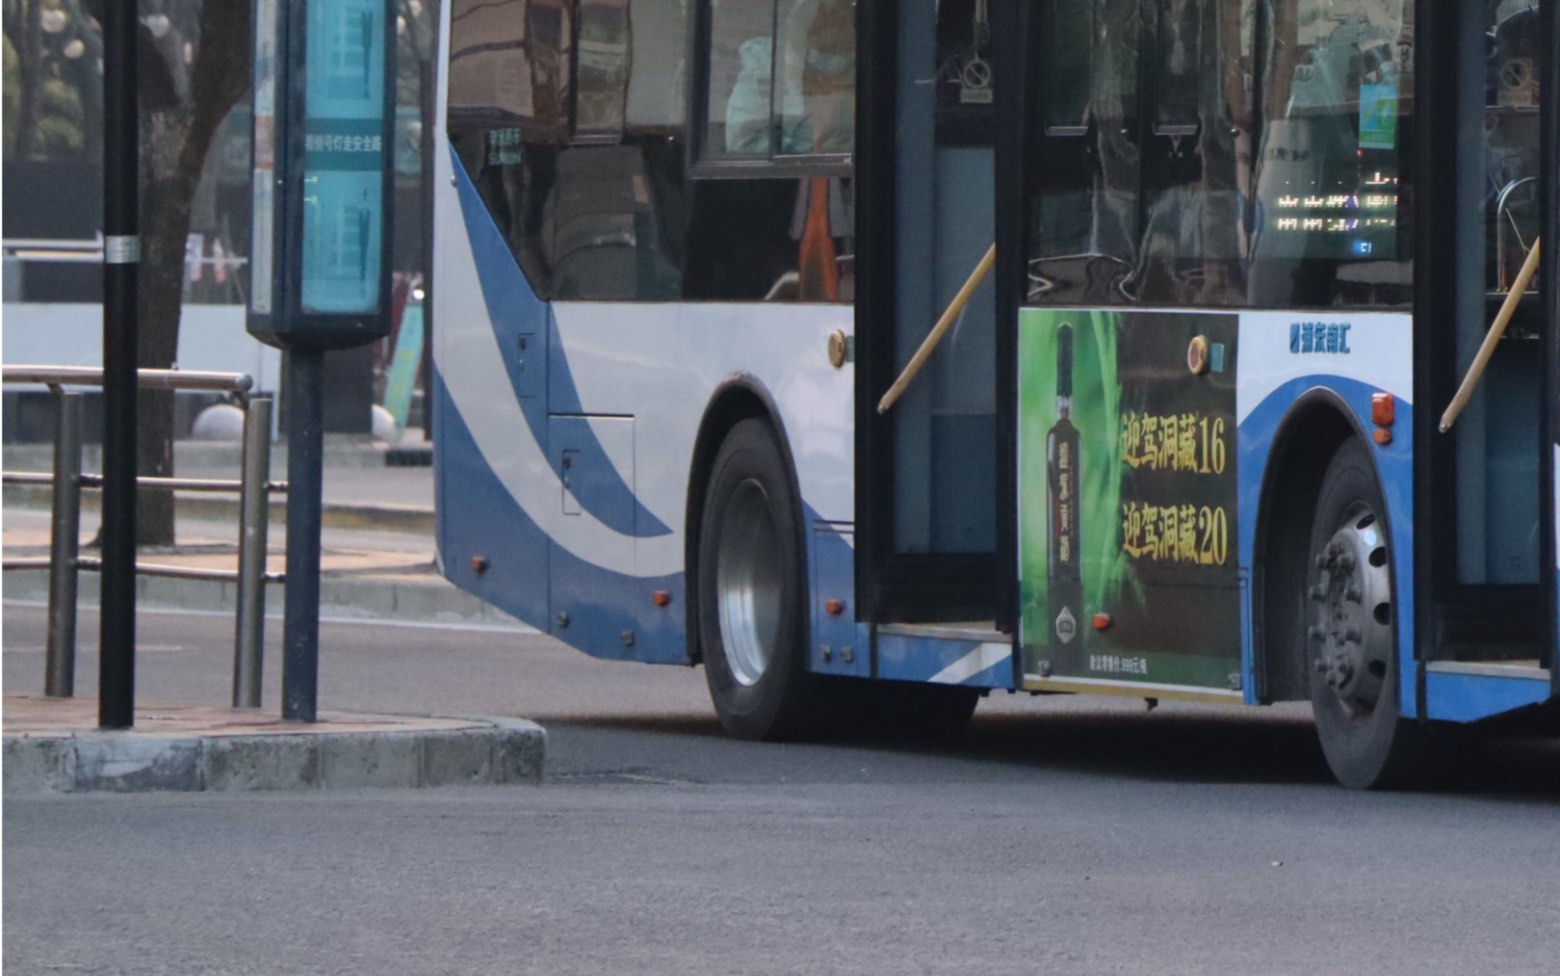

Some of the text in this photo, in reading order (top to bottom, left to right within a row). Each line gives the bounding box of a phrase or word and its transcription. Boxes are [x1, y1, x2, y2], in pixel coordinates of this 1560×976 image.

[1121, 411, 1226, 474] 迎驾洞藏16
[1121, 503, 1228, 565] 迎驾洞藏20
